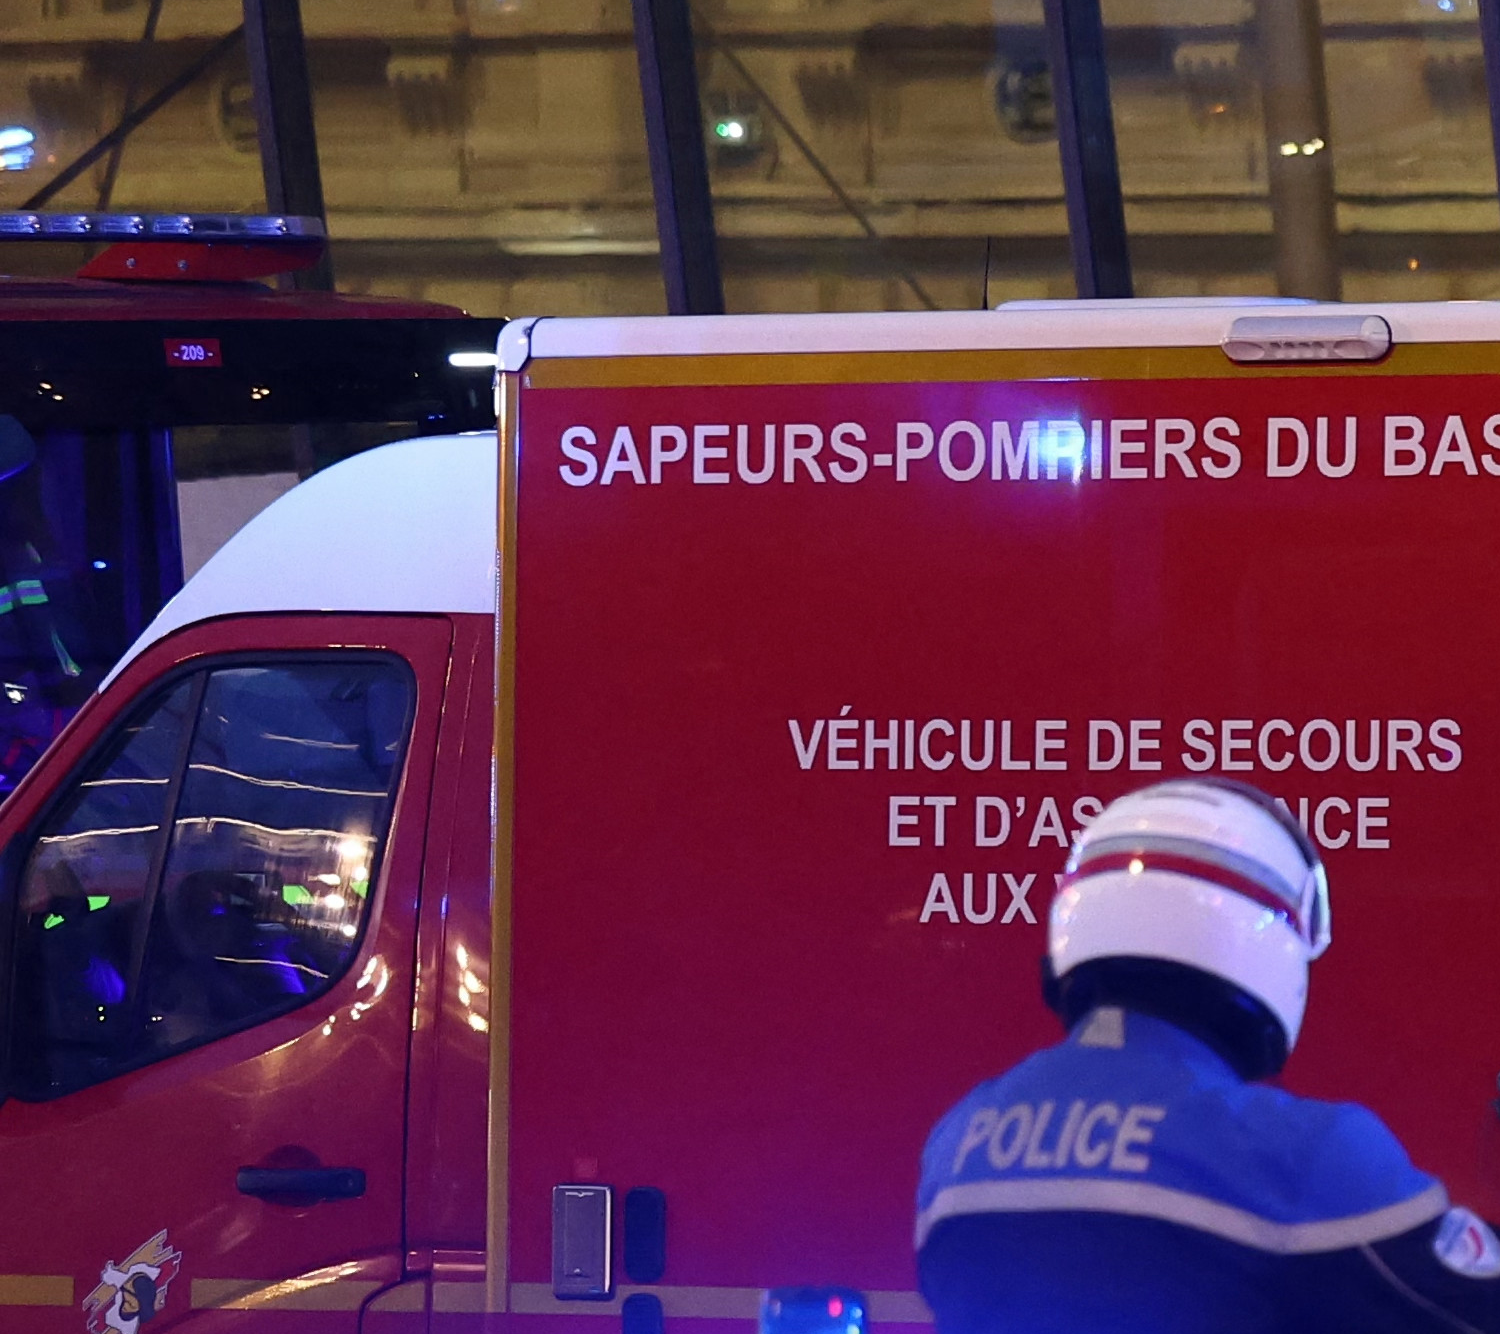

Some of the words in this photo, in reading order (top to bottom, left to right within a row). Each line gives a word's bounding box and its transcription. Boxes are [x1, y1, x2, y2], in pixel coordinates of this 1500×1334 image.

[558, 417, 1242, 486] SAPEURS-POMPIERS
[1267, 416, 1358, 479] DU
[788, 706, 1072, 772] VÉHICULE
[1085, 720, 1161, 772] DE
[1180, 718, 1463, 773] SECOURS
[888, 796, 956, 847] ET
[918, 873, 1038, 924] AUX
[952, 1099, 1167, 1175] POLICE
